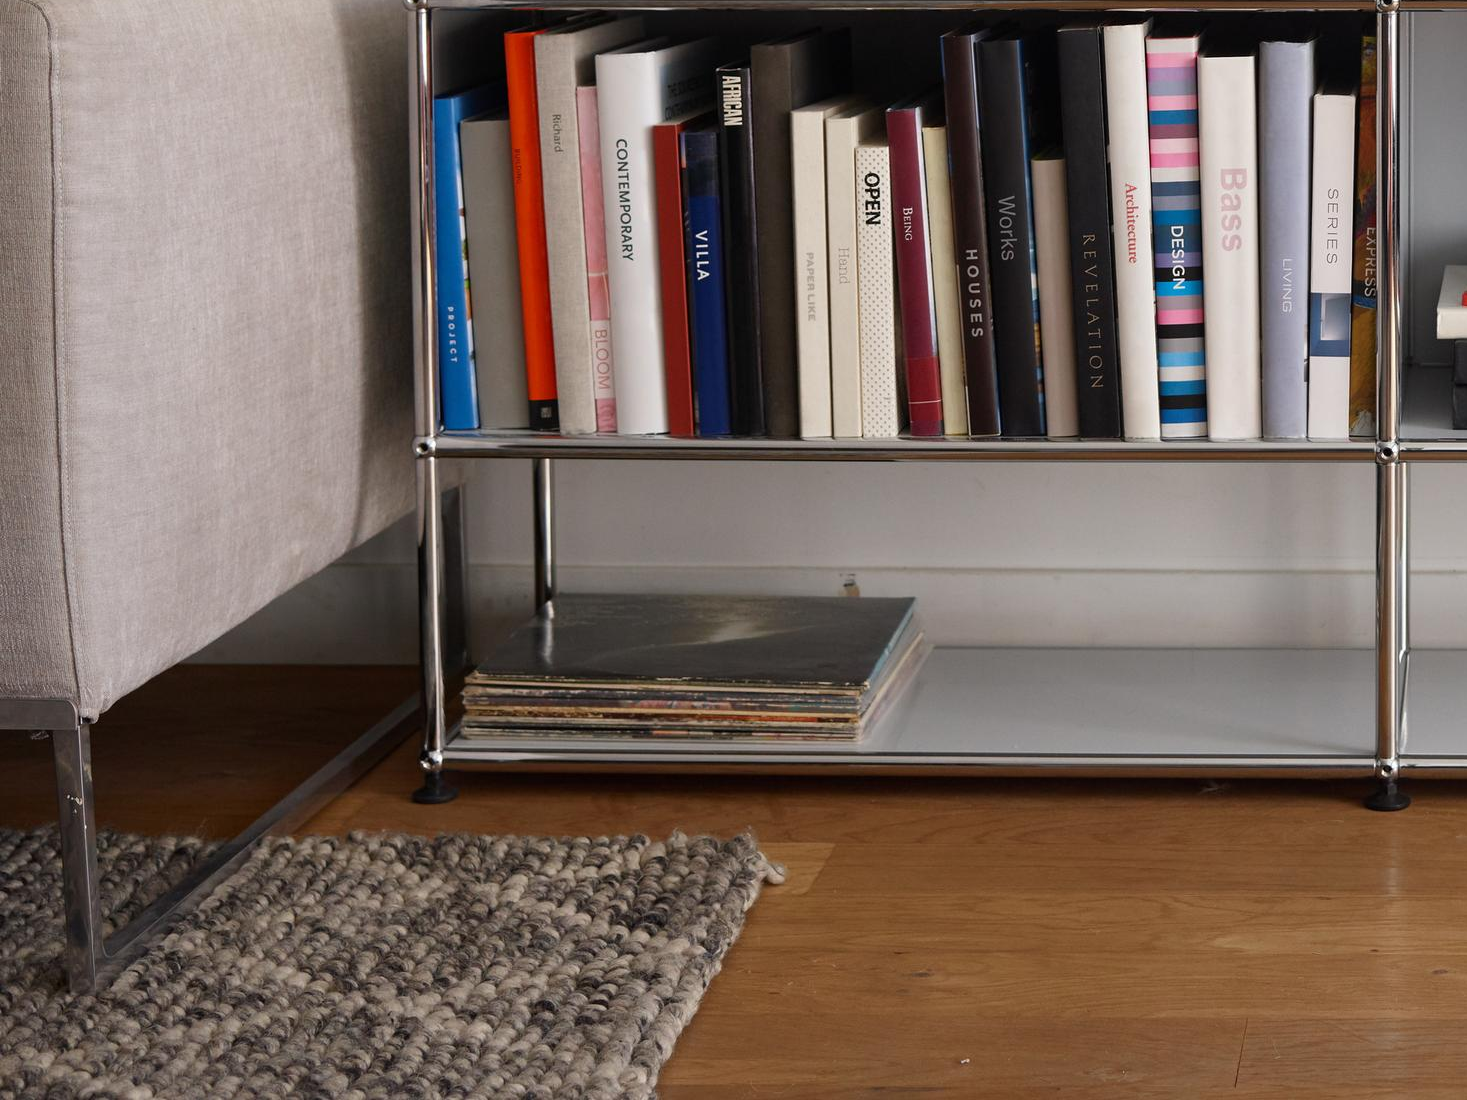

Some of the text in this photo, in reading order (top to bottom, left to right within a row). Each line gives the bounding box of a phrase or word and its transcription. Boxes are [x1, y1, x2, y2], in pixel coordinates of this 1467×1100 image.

[551, 113, 563, 152] Richard
[722, 75, 743, 126] AFRICAN
[616, 139, 634, 261] CONTEMPORARY
[864, 172, 881, 226] OPEN
[998, 195, 1018, 261] Works
[1125, 183, 1139, 264] Architecture
[1220, 168, 1247, 252] Bass
[1326, 188, 1339, 264] SERIES
[694, 230, 710, 281] VILLA
[838, 247, 850, 285] Hand
[1171, 225, 1186, 290] DESIGN
[1282, 258, 1293, 313] LIVING
[1364, 227, 1377, 298] EXPRESS
[965, 249, 984, 337] HOUSES
[1082, 234, 1104, 388] REVELATION
[447, 306, 458, 363] PROJECT
[594, 328, 611, 390] BLOOM
